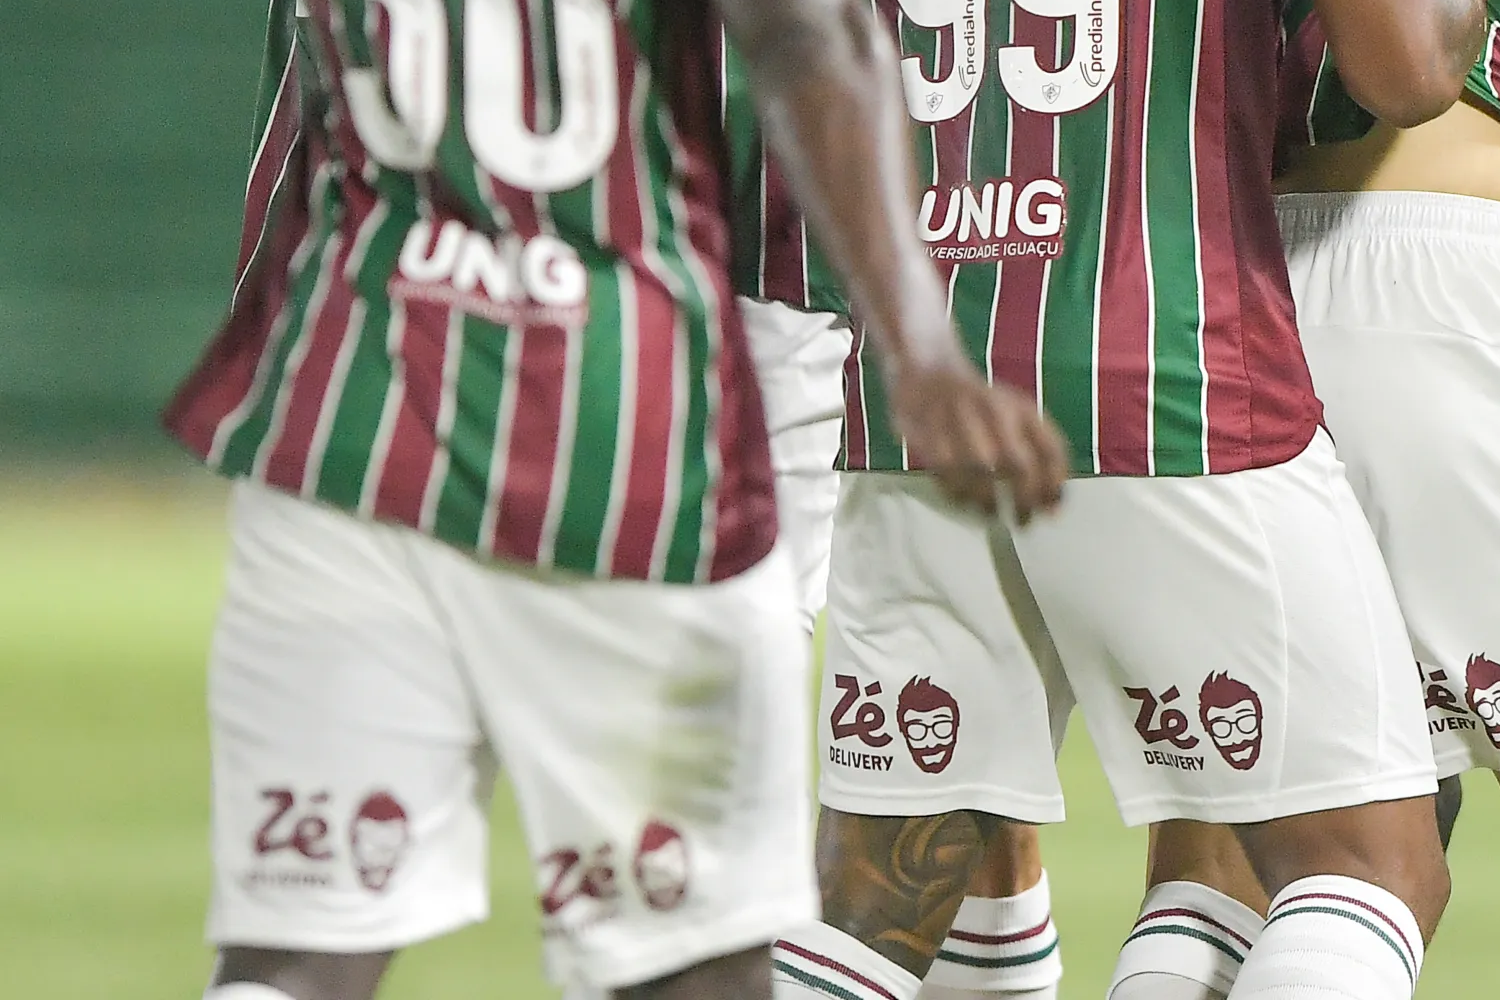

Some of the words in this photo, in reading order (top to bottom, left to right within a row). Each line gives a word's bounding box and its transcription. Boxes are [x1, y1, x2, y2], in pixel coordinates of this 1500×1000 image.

[916, 178, 1064, 243] UNIG
[398, 219, 588, 306] UNG
[924, 243, 1000, 260] IVERSIDADE
[1002, 241, 1059, 258] IGUAÇU
[830, 674, 894, 748] Zé
[1122, 684, 1200, 749] Zé
[1428, 717, 1476, 735] IVERY
[829, 746, 894, 772] DELIVERY
[1143, 750, 1205, 771] DELIVERY
[254, 787, 334, 860] Zé
